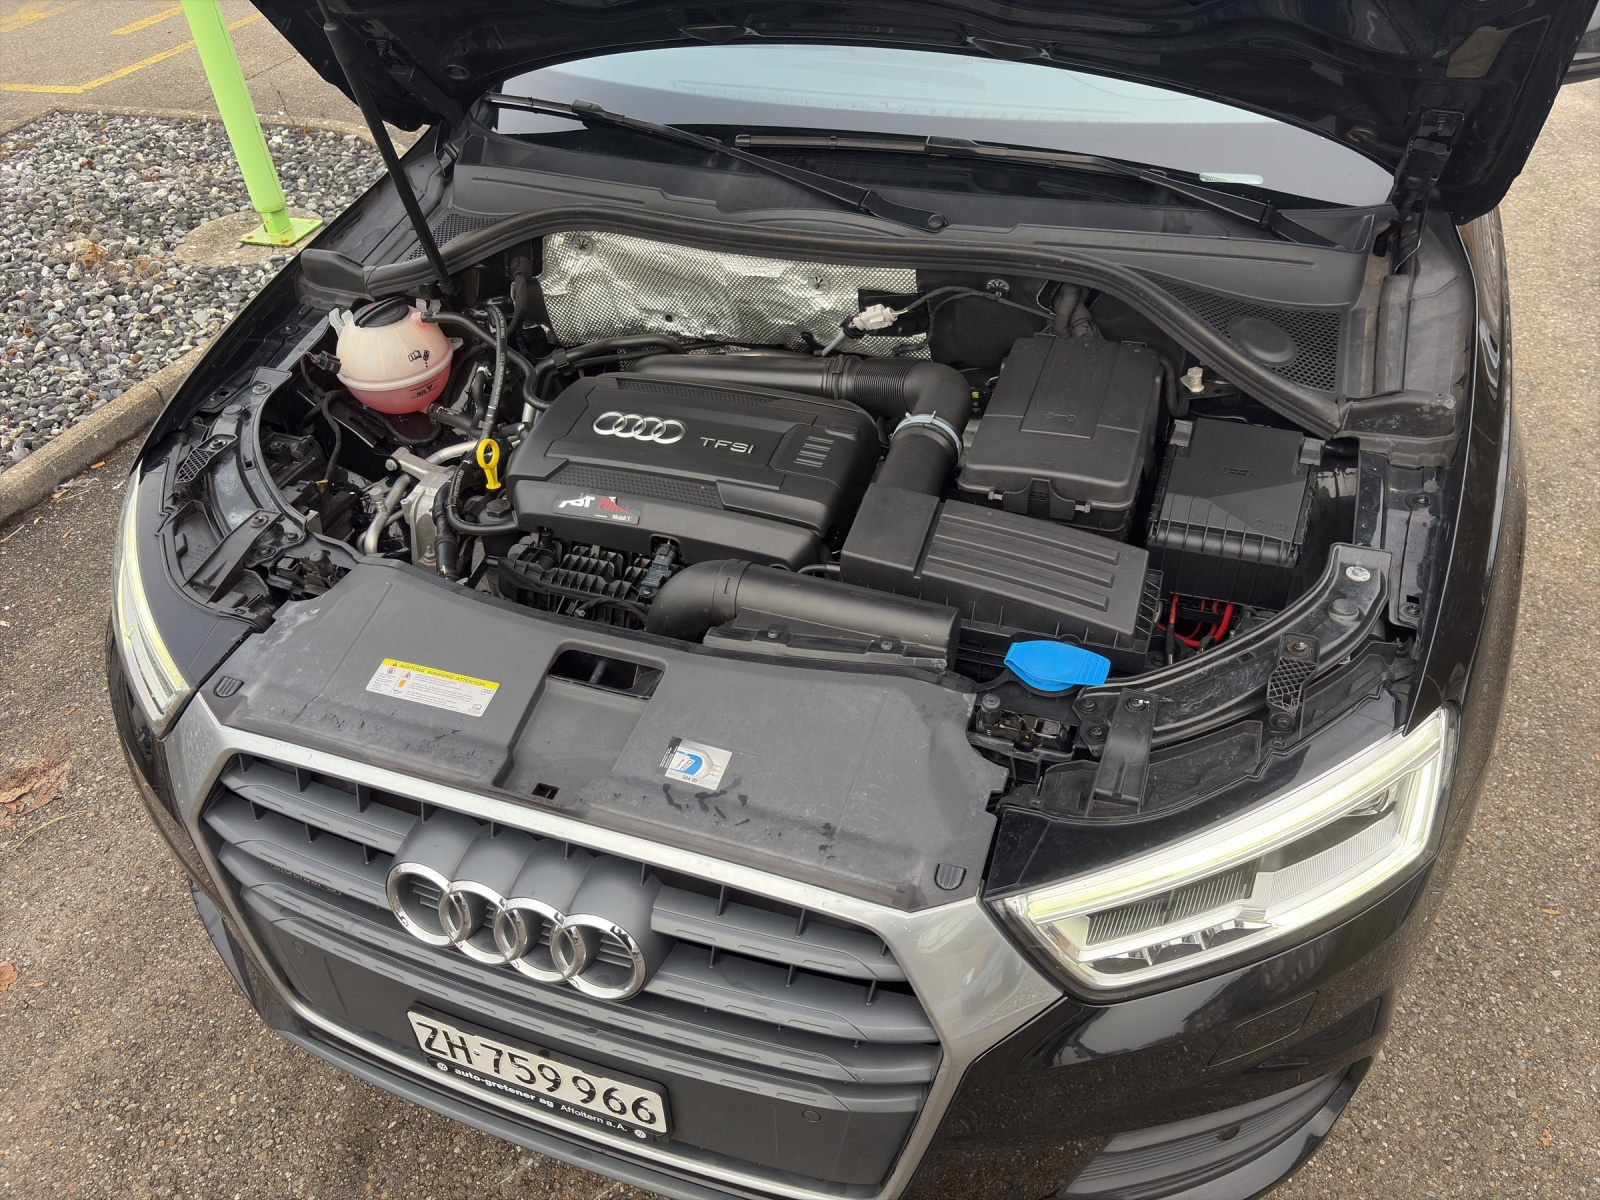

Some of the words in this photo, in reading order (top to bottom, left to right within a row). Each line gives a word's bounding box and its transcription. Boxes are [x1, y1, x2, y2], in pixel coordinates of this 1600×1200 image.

[700, 436, 755, 454] TFSI
[399, 663, 425, 673] ACHTUNG
[427, 670, 454, 680] WARNING
[455, 676, 487, 687] ATTENTION
[454, 1068, 536, 1101] auto-gretener
[538, 1098, 554, 1109] ag
[560, 1104, 604, 1124] Affoltern
